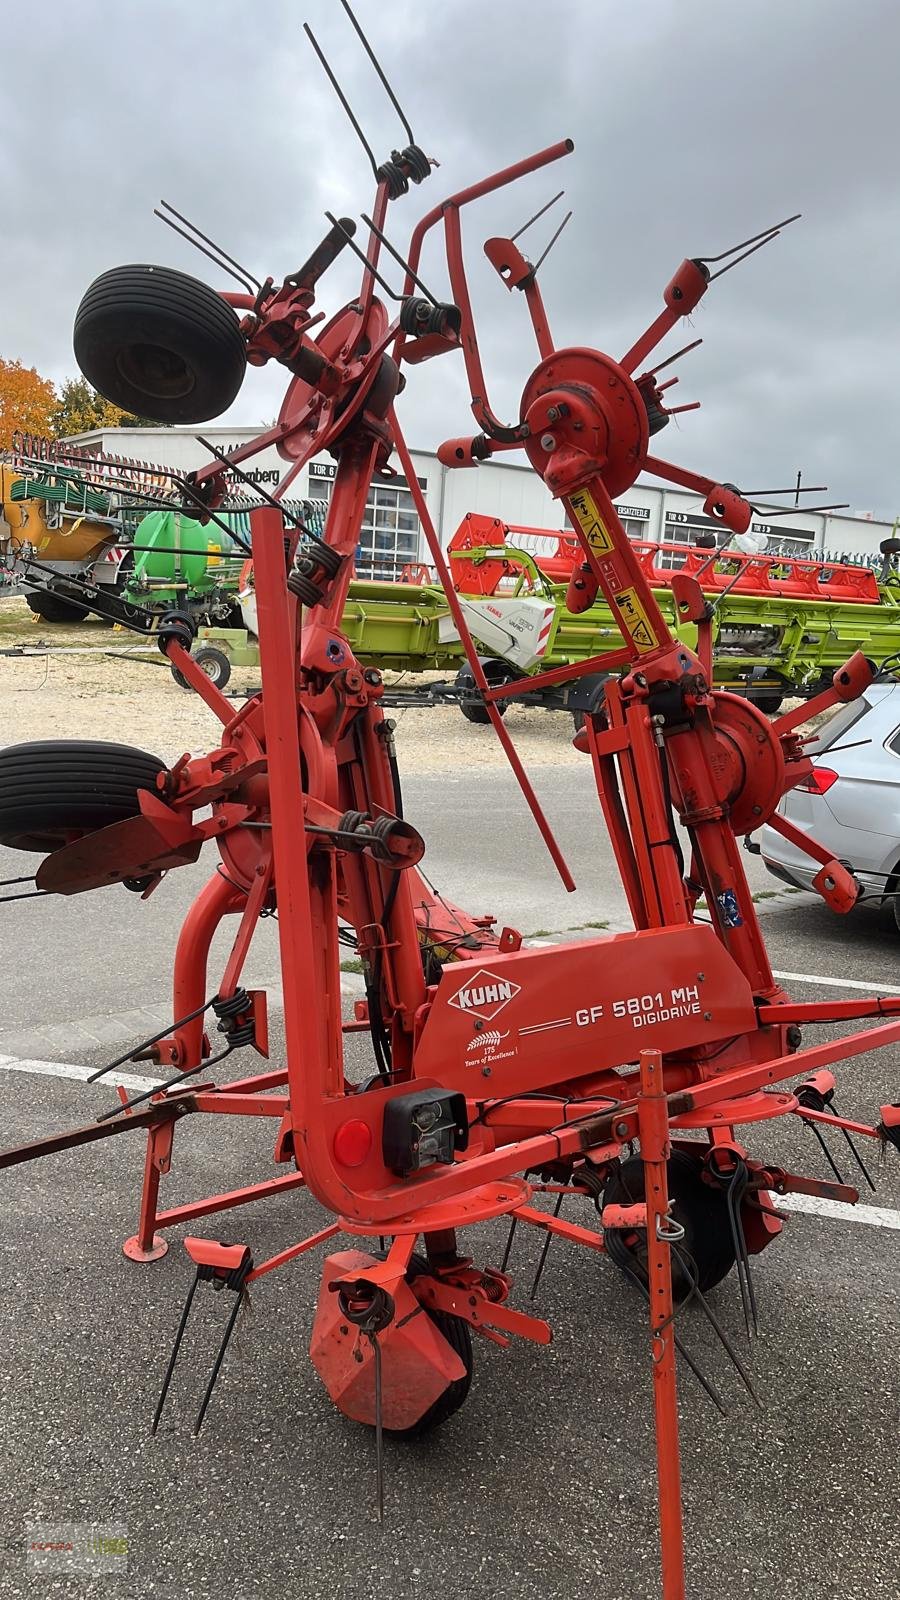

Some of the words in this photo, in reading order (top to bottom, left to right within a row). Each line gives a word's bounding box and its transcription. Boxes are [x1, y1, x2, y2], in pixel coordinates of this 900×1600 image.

[313, 464, 326, 475] TOR
[329, 465, 334, 476] 6
[618, 506, 648, 518] ERSATZTEILE
[668, 512, 677, 521] TOR
[677, 513, 682, 521] 4
[458, 982, 512, 1009] KUHN
[575, 1005, 603, 1026] GF
[612, 993, 664, 1018] 5801
[671, 985, 699, 1005] MH
[632, 1002, 701, 1028] DIGIDRIVE
[465, 1057, 480, 1067] Years
[480, 1054, 488, 1064] of
[487, 1049, 515, 1062] Excellence
[484, 1046, 495, 1056] 175
